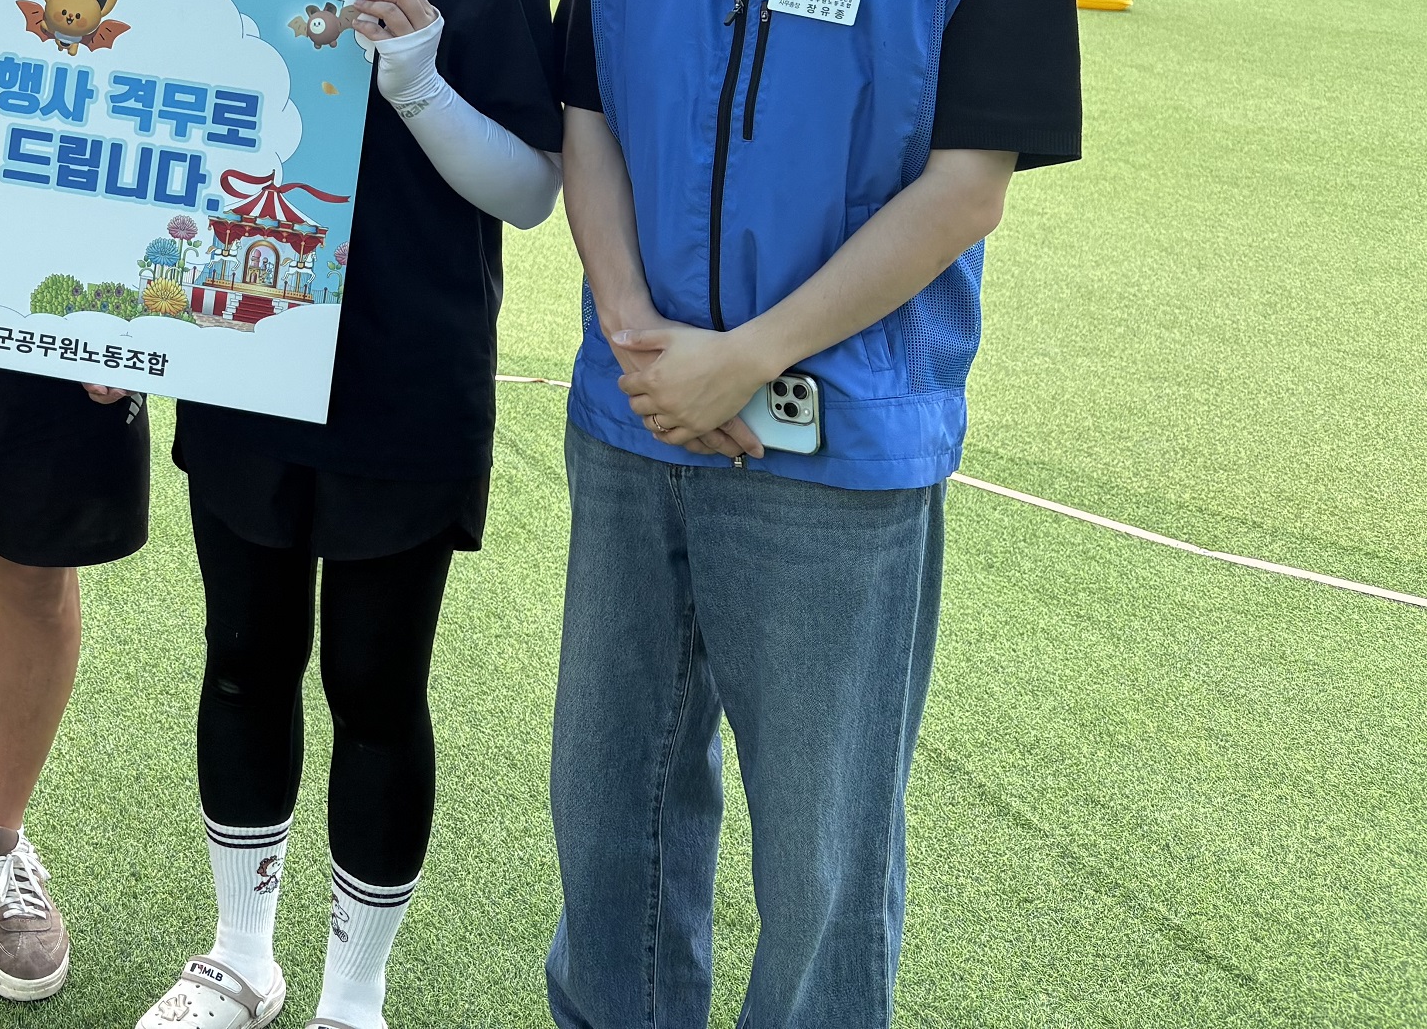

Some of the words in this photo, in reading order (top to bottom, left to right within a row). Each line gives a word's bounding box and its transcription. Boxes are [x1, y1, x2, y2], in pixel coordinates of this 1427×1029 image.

[108, 74, 260, 148] 격무로
[2, 126, 221, 212] 드립니다.
[201, 966, 224, 982] MLB
